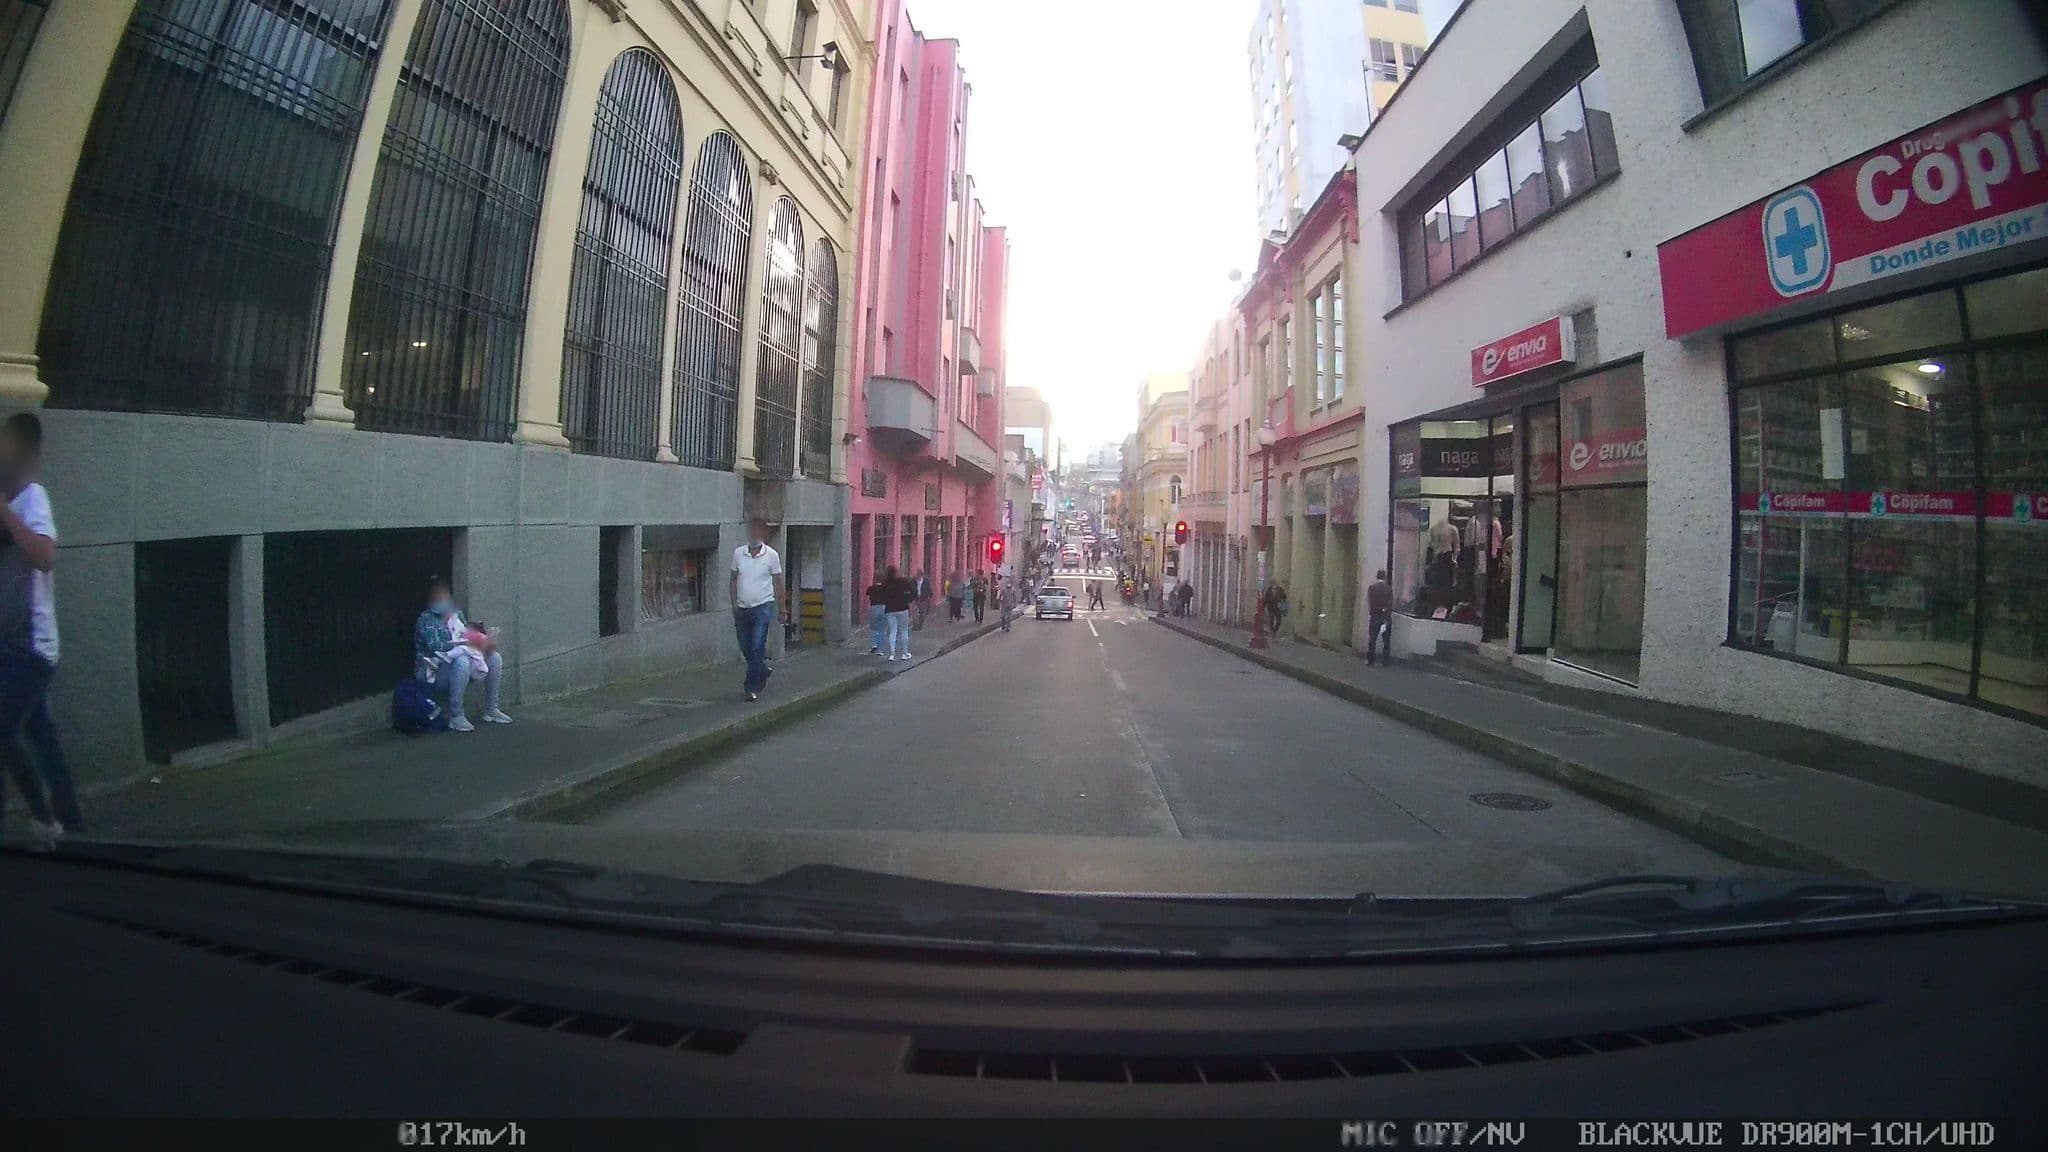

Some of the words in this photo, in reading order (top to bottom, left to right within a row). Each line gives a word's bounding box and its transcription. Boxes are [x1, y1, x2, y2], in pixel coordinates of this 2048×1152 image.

[1870, 237, 1951, 275] Donde
[1956, 214, 2033, 250] Mejor
[1507, 335, 1546, 362] envia
[1441, 450, 1480, 468] naga
[1774, 494, 1826, 510] Copifam
[1890, 494, 1953, 513] Copifam
